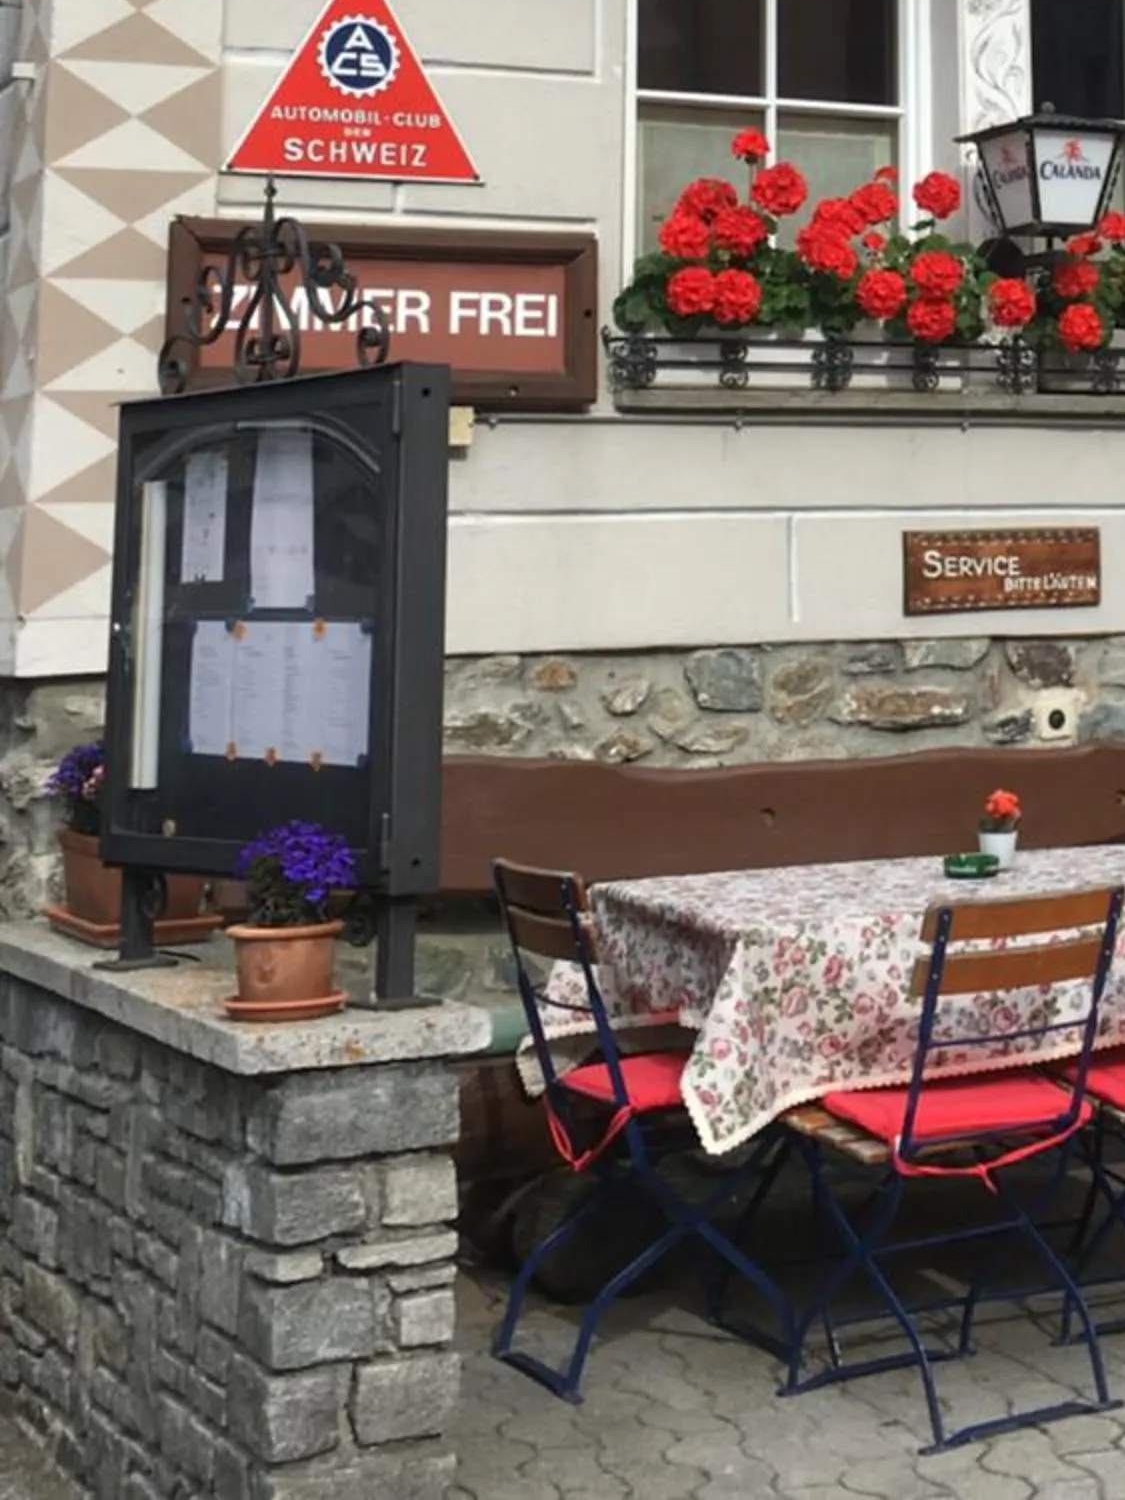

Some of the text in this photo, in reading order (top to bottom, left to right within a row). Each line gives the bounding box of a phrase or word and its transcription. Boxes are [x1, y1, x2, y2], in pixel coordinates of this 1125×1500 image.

[283, 136, 428, 167] SCHWEIZ
[1039, 159, 1101, 181] CALANDA
[449, 291, 559, 338] FREI
[922, 549, 1021, 578] SERVICE
